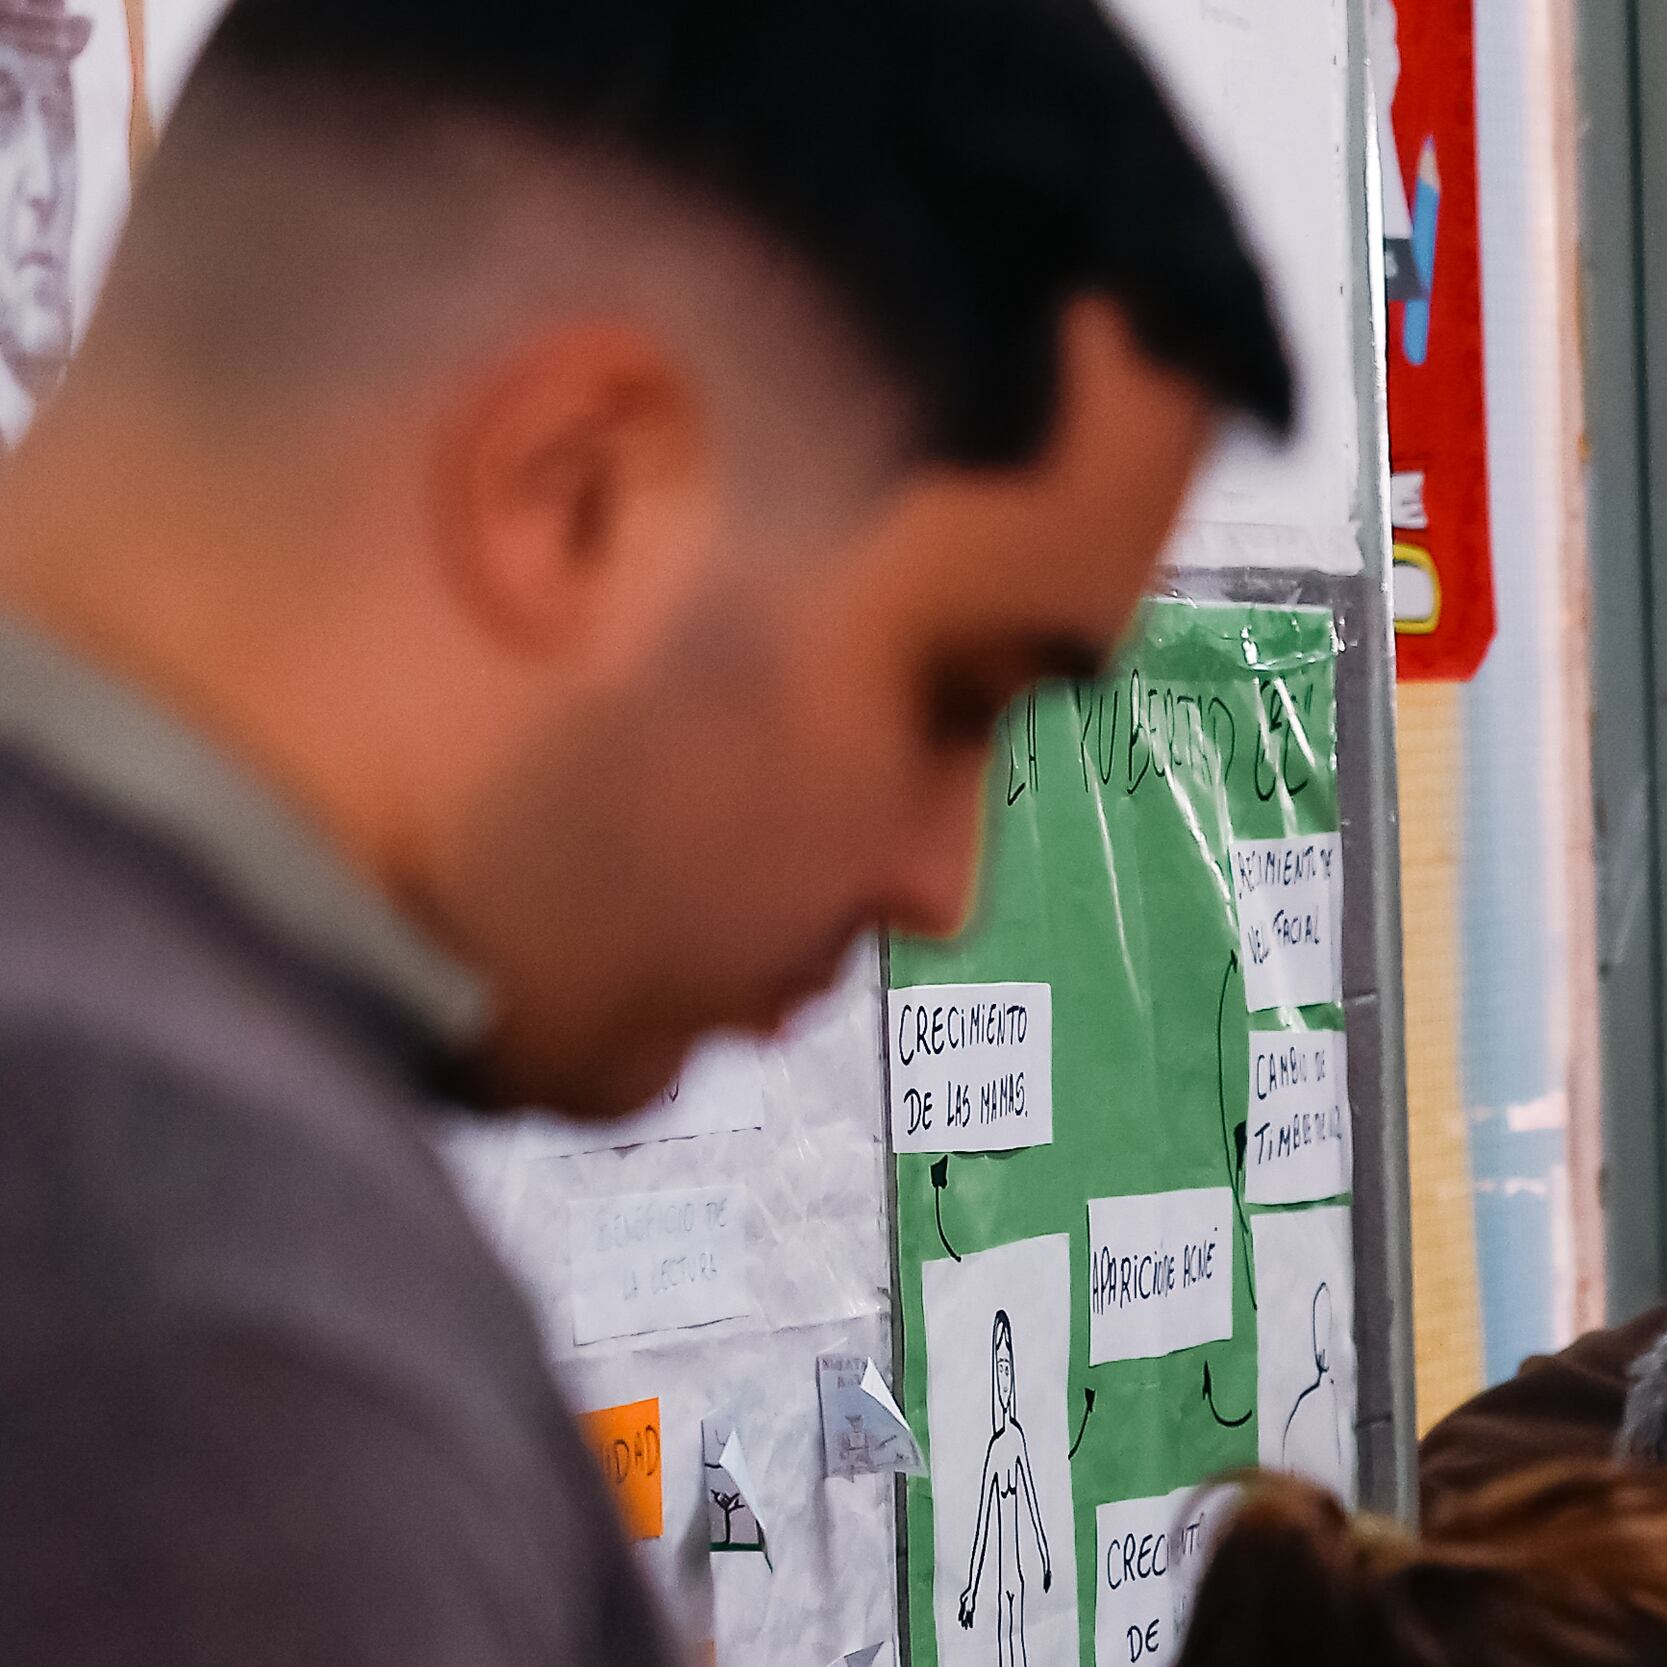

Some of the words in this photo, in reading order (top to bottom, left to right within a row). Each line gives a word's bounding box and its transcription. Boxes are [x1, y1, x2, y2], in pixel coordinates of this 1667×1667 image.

[903, 1087, 933, 1136] DE
[946, 1080, 971, 1128] LAS
[1126, 1618, 1160, 1664] DE
